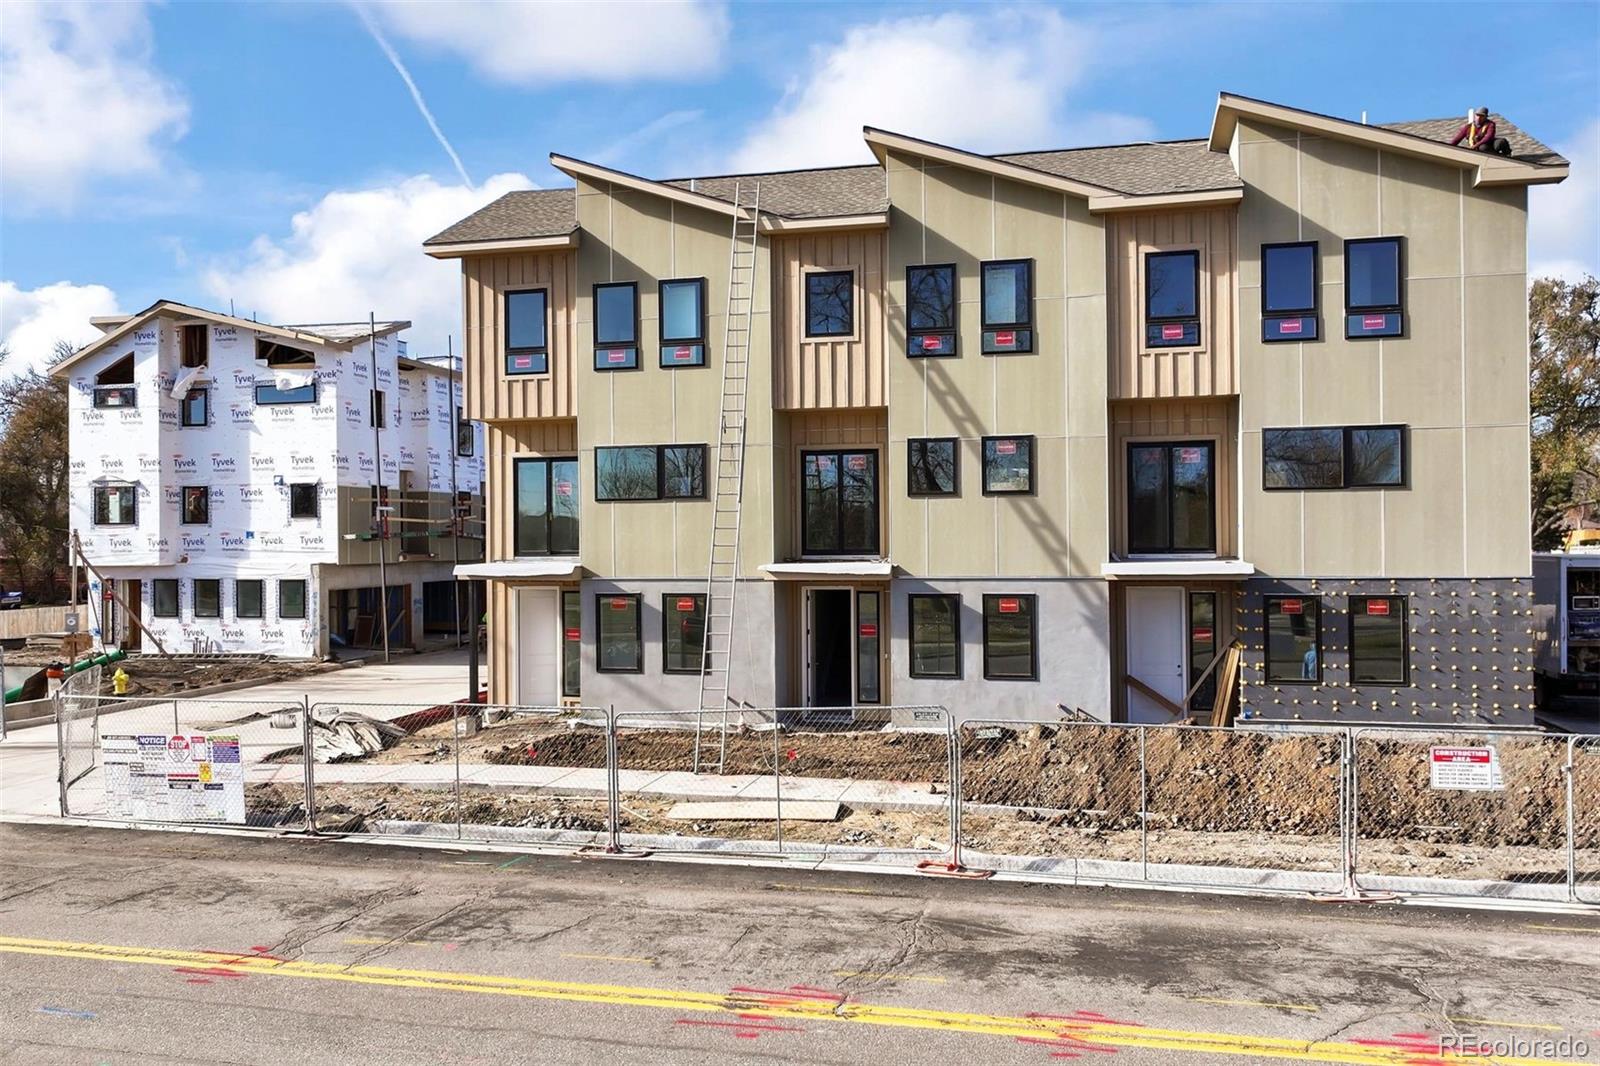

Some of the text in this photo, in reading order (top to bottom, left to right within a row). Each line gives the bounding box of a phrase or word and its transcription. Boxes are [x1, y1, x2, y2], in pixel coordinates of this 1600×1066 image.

[134, 331, 156, 340] Tyvek
[214, 328, 237, 336] Tyvek
[353, 362, 367, 372] Tyvek
[377, 368, 391, 377] Tyvek
[231, 410, 253, 418] Tyvek
[270, 408, 294, 416] Tyvek
[311, 406, 333, 415] Tyvek
[346, 408, 360, 416] Tyvek
[82, 412, 104, 421] Tyvek
[120, 411, 142, 420] Tyvek
[101, 459, 123, 468] Tyvek
[139, 459, 161, 467] Tyvek
[174, 459, 196, 467] Tyvek
[212, 458, 234, 466] Tyvek
[251, 457, 274, 465] Tyvek
[291, 456, 314, 464] Tyvek
[331, 455, 349, 464] Tyvek
[359, 457, 373, 465] Tyvek
[383, 459, 396, 468] Tyvek
[165, 490, 180, 498] Tyve
[211, 489, 224, 497] vek
[240, 488, 262, 497] Tyvek
[110, 539, 131, 547] Tyvek
[148, 538, 168, 546] Tyvek
[182, 538, 204, 546] Tyvek
[220, 537, 243, 545] Tyvek
[260, 537, 283, 545] Tyvek
[300, 536, 323, 545] Tyvek
[183, 628, 205, 638] Tyvek
[221, 629, 244, 638] Tyvek
[261, 629, 284, 639] Tyvek
[170, 740, 188, 749] STOP
